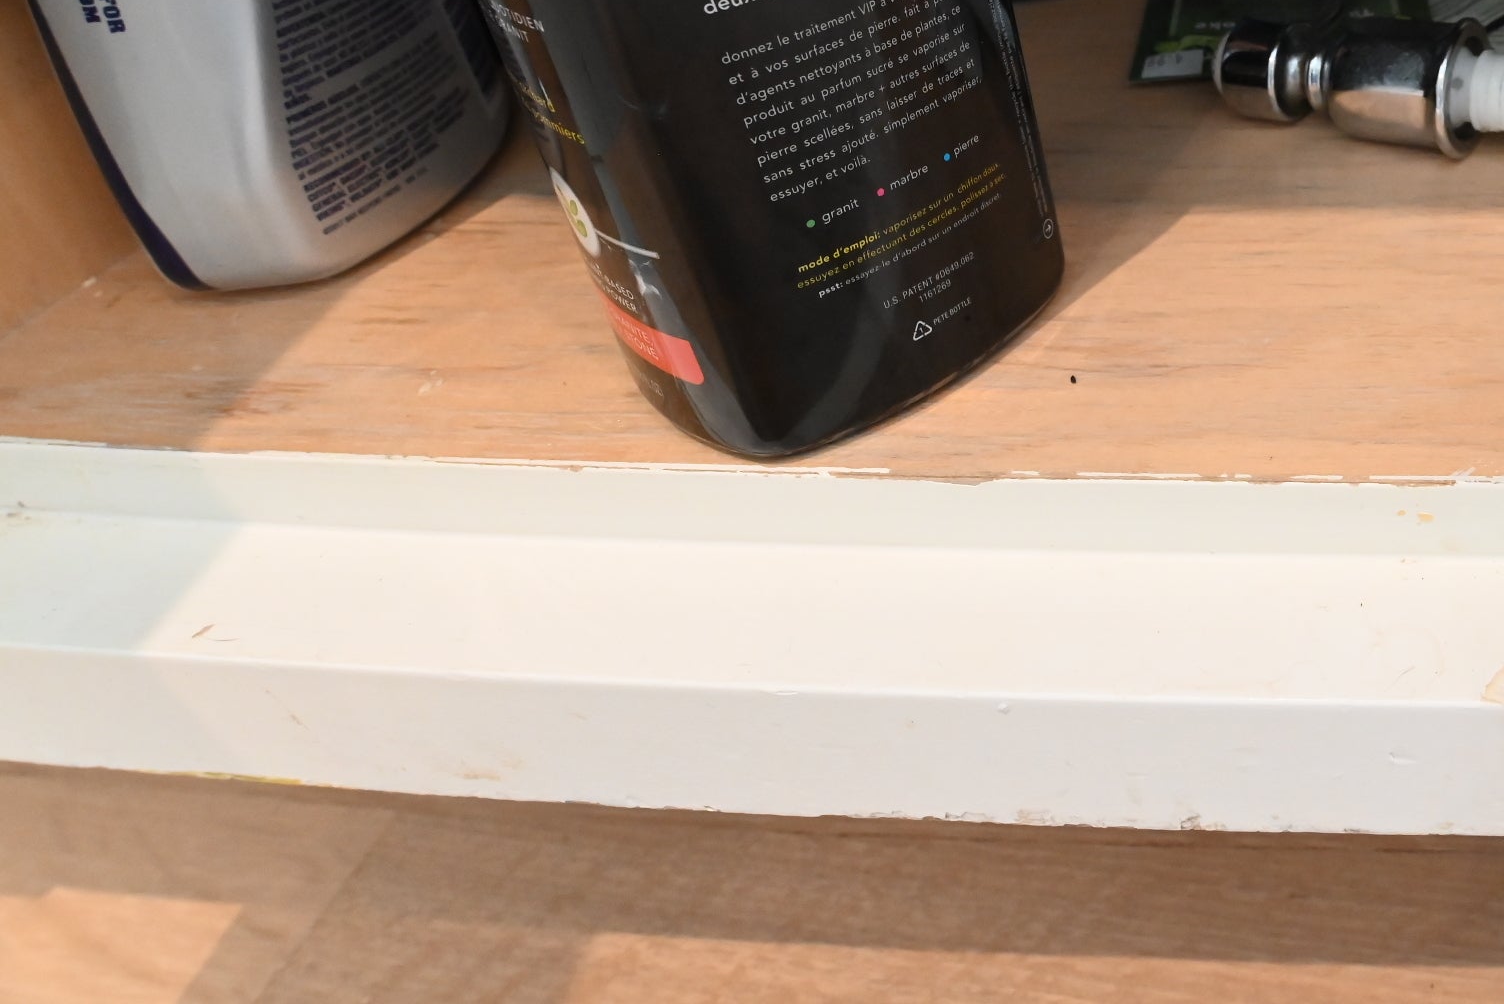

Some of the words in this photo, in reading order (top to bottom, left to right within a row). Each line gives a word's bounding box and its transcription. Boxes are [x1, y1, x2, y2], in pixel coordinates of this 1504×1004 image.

[721, 41, 774, 65] donnez
[777, 35, 790, 47] le
[794, 10, 856, 42] traitement
[858, 0, 876, 16] VIP
[729, 73, 744, 85] et
[751, 68, 759, 79] à
[765, 59, 788, 73] vos
[794, 39, 844, 64] surfaces
[850, 30, 863, 42] de
[904, 5, 920, 18] fait
[953, 135, 979, 158] pierre
[770, 178, 823, 202] essuyer,
[826, 170, 838, 181] et
[841, 157, 871, 173] voilà.
[890, 165, 928, 191] marbre
[822, 200, 859, 225] granit
[798, 255, 830, 273] mode
[903, 277, 933, 300] PATENT
[950, 298, 971, 316] BOTTLE
